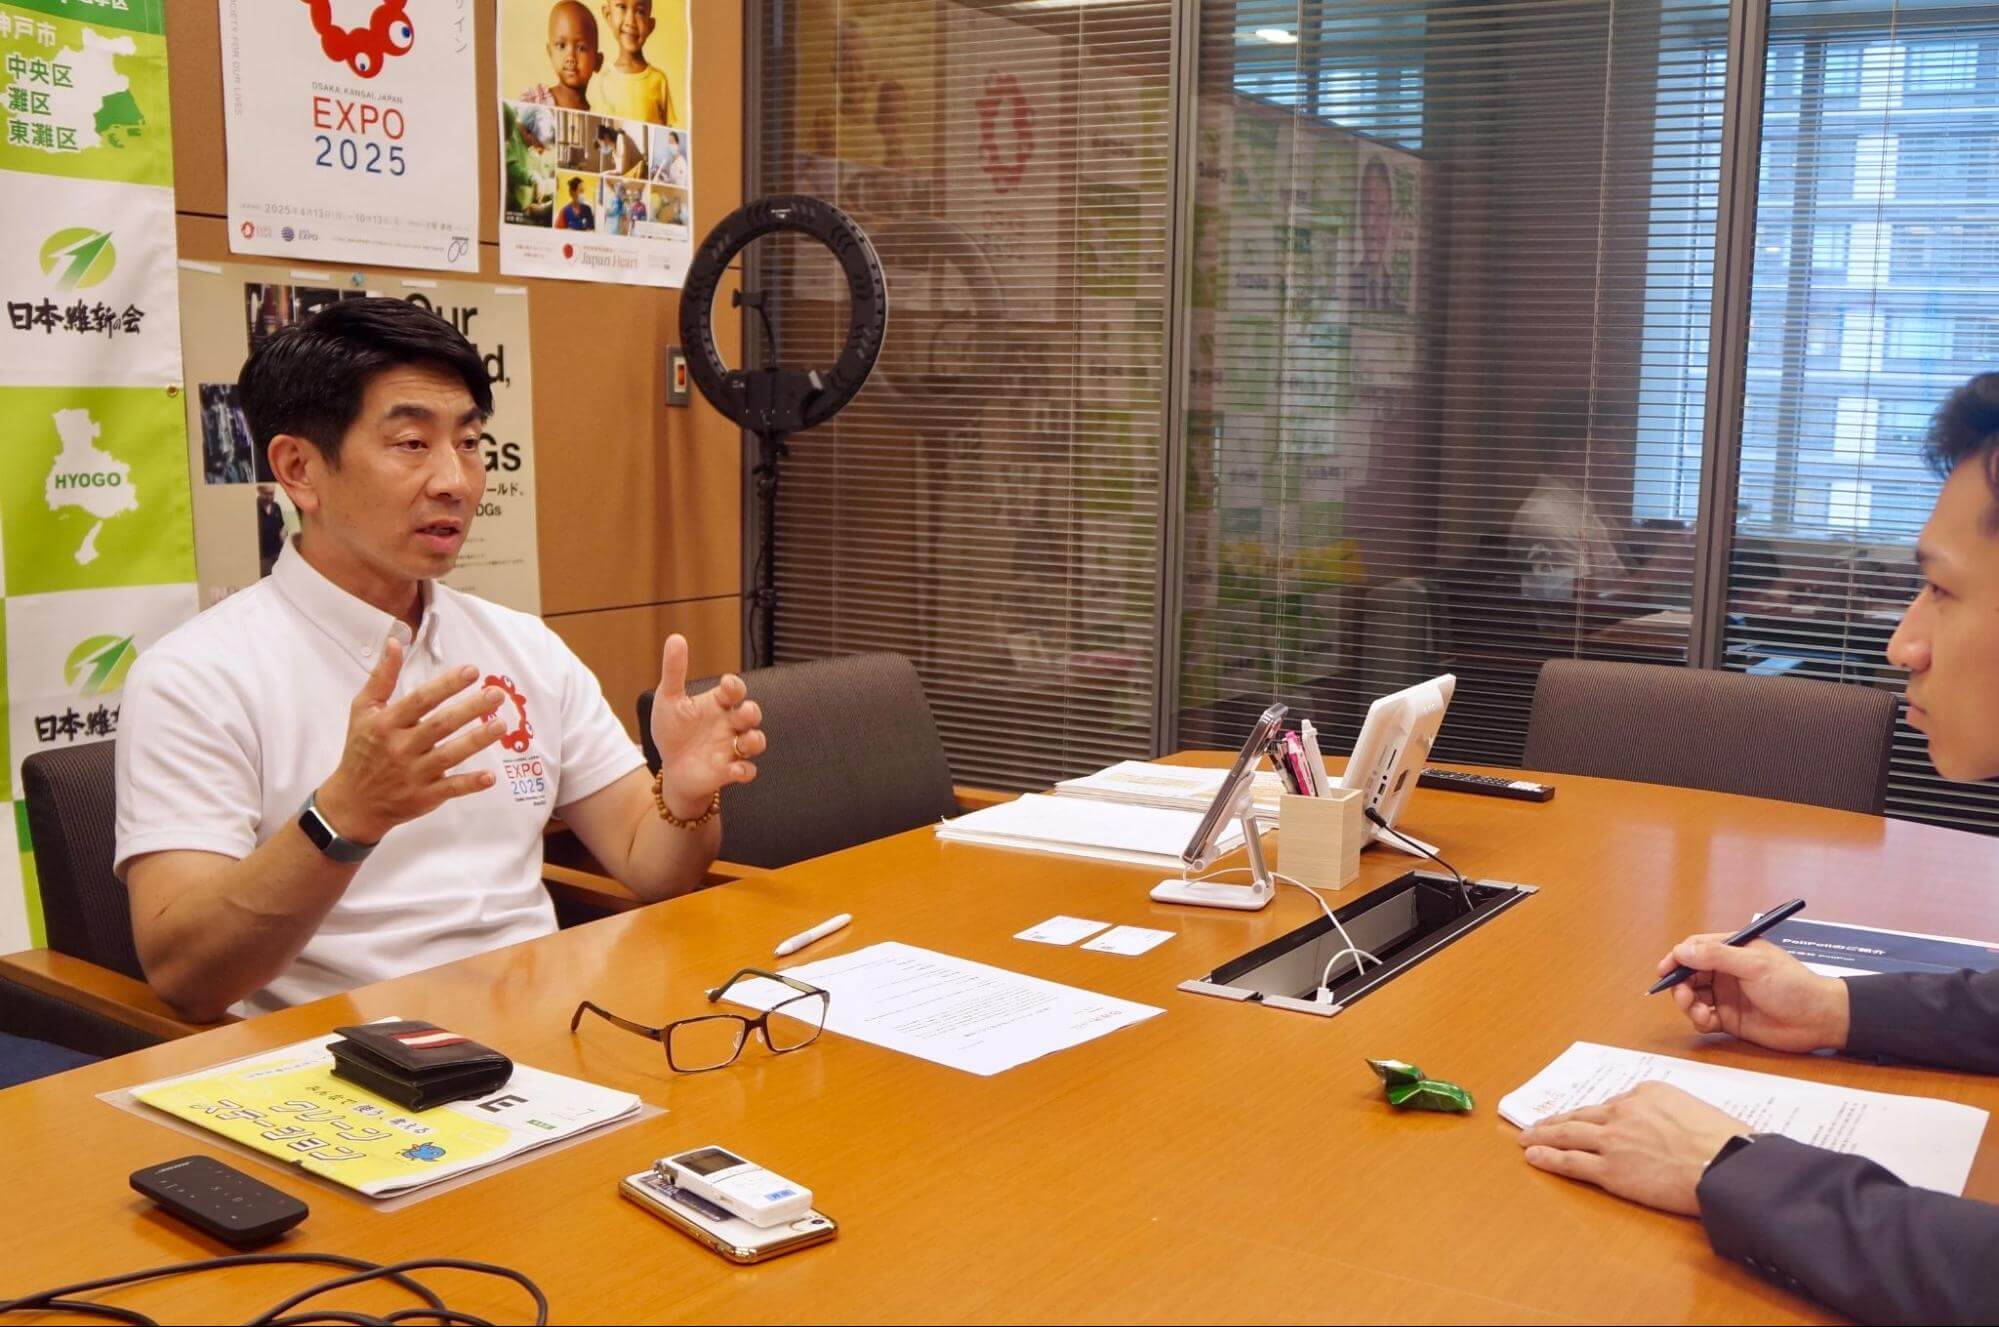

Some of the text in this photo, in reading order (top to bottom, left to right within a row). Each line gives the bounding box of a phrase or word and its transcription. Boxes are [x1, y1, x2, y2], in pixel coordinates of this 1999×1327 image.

[8, 54, 74, 88] 中央区
[8, 86, 52, 116] 灘区
[313, 95, 405, 140] EXPO
[9, 119, 78, 151] 東灘区
[315, 135, 405, 176] 2025
[581, 251, 610, 267] Japan
[8, 297, 145, 339] 日本維新の会
[55, 472, 121, 489] HYOGO
[486, 482, 524, 496] ールド、
[504, 761, 542, 779] EXPO
[511, 777, 545, 795] 2025
[189, 1099, 367, 1161] ステーション
[268, 1100, 393, 1142] クリーン
